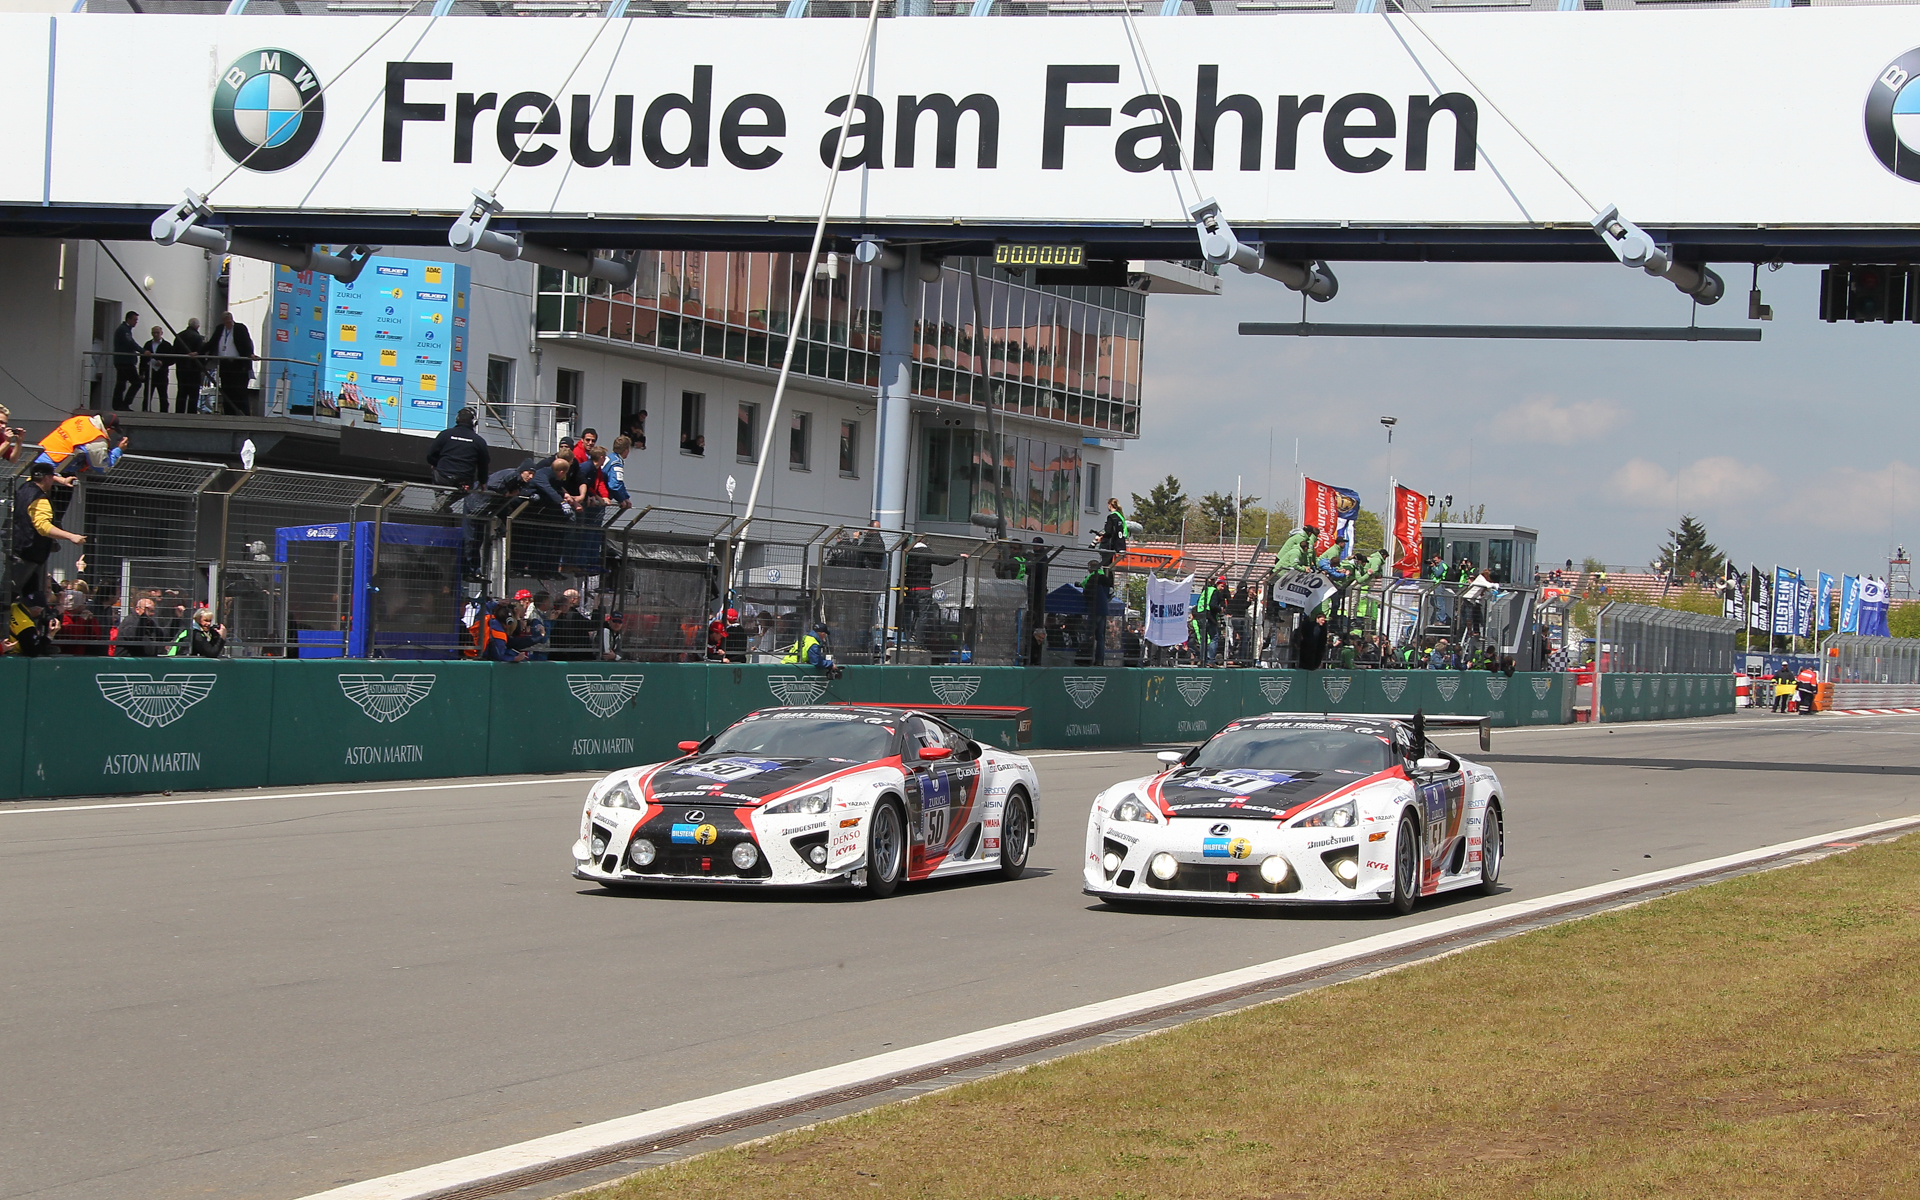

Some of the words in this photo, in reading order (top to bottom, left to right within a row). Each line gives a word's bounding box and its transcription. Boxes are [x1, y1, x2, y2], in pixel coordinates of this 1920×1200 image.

[223, 52, 317, 92] BMW
[381, 61, 787, 171] Freude
[819, 92, 1000, 171] am
[1041, 64, 1478, 174] Fahren
[995, 245, 1082, 265] 00.00.00
[425, 266, 441, 274] ADAC
[336, 291, 362, 300] ZURICH
[376, 316, 402, 324] ZURICH
[341, 324, 357, 332] ADAC
[416, 341, 442, 349] ZURICH
[380, 349, 397, 357] ADAC
[1775, 580, 1790, 634] BILSTEIN
[1841, 579, 1860, 629] FALKEN
[1758, 608, 1768, 631] GRAN
[132, 684, 155, 696] ASTON
[156, 684, 181, 696] MARTIN
[368, 684, 386, 694] ASTON
[386, 684, 407, 694] MARTIN
[1065, 724, 1082, 737] ASTON
[1082, 723, 1101, 736] MARTIN
[1293, 722, 1348, 730] TURISMO
[571, 739, 601, 755] ASTON
[602, 738, 634, 754] MARTIN
[345, 746, 382, 765] ASTON
[383, 745, 423, 763] MARTIN
[103, 753, 149, 775] ASTON
[152, 752, 201, 773] MARTIN
[700, 763, 747, 776] 50
[696, 783, 728, 791] GR
[1211, 775, 1257, 788] 51
[651, 791, 706, 799] GAZOO
[707, 791, 762, 803] Racing
[928, 795, 946, 808] ZURICH
[1167, 803, 1227, 811] GAZOO
[1228, 803, 1287, 815] Racing
[1431, 808, 1444, 820] ZURICH
[782, 821, 827, 836] BRIDGESTONE
[927, 810, 945, 846] 50
[833, 830, 861, 846] DENSO
[1307, 835, 1355, 849] BRIDGESTONE
[835, 844, 857, 857] KYB
[1203, 843, 1229, 851] BILSTEIN
[1366, 860, 1389, 871] KYB
